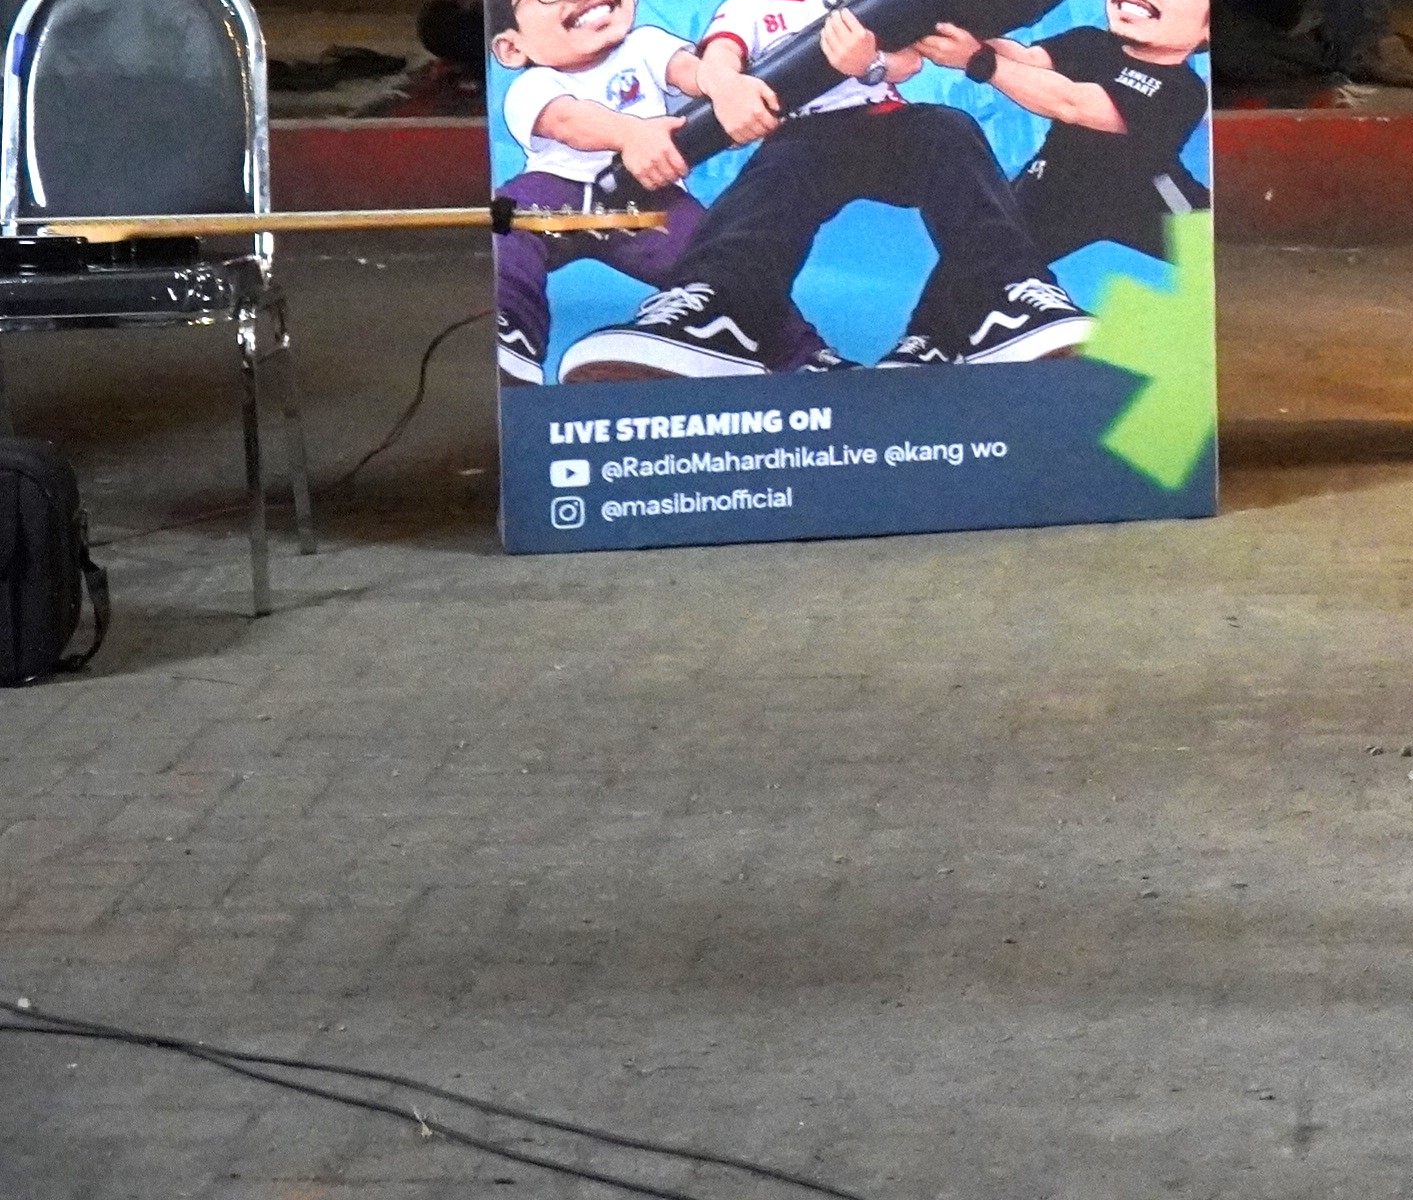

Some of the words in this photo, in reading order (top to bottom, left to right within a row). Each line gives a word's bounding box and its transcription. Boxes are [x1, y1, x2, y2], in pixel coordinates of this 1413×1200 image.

[549, 419, 611, 445] LIVE
[615, 409, 783, 442] STREAMING
[788, 406, 833, 432] ON
[601, 443, 878, 483] @RadioMahardhikaLive
[883, 440, 964, 467] @kang
[970, 440, 1008, 459] wo
[601, 486, 793, 522] @masibinofficial
